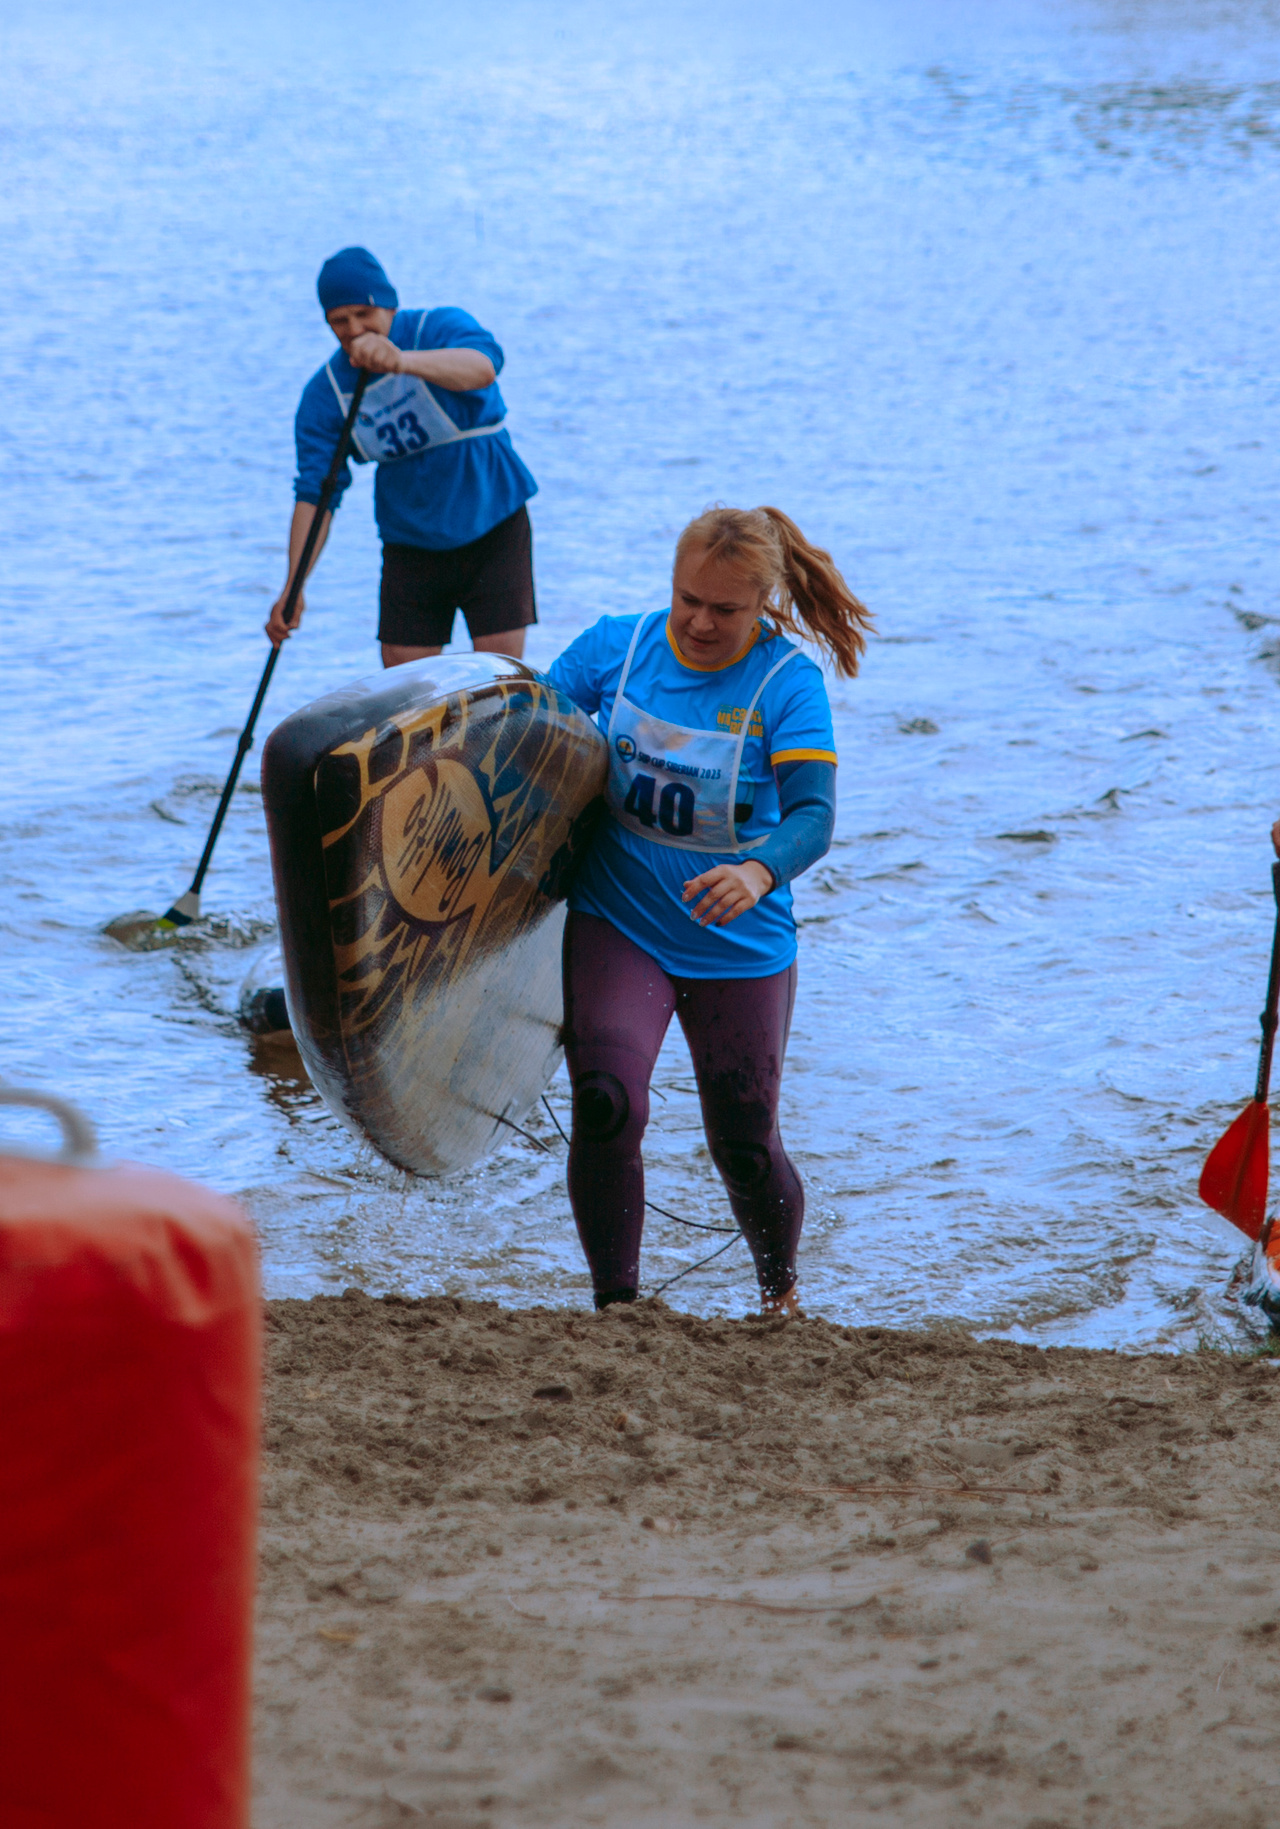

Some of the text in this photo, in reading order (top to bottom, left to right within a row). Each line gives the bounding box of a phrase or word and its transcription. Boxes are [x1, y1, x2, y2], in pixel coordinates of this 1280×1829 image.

[376, 410, 430, 458] 33
[638, 751, 722, 780] SUP CUP SIBERIAN 2023
[624, 773, 696, 837] 40
